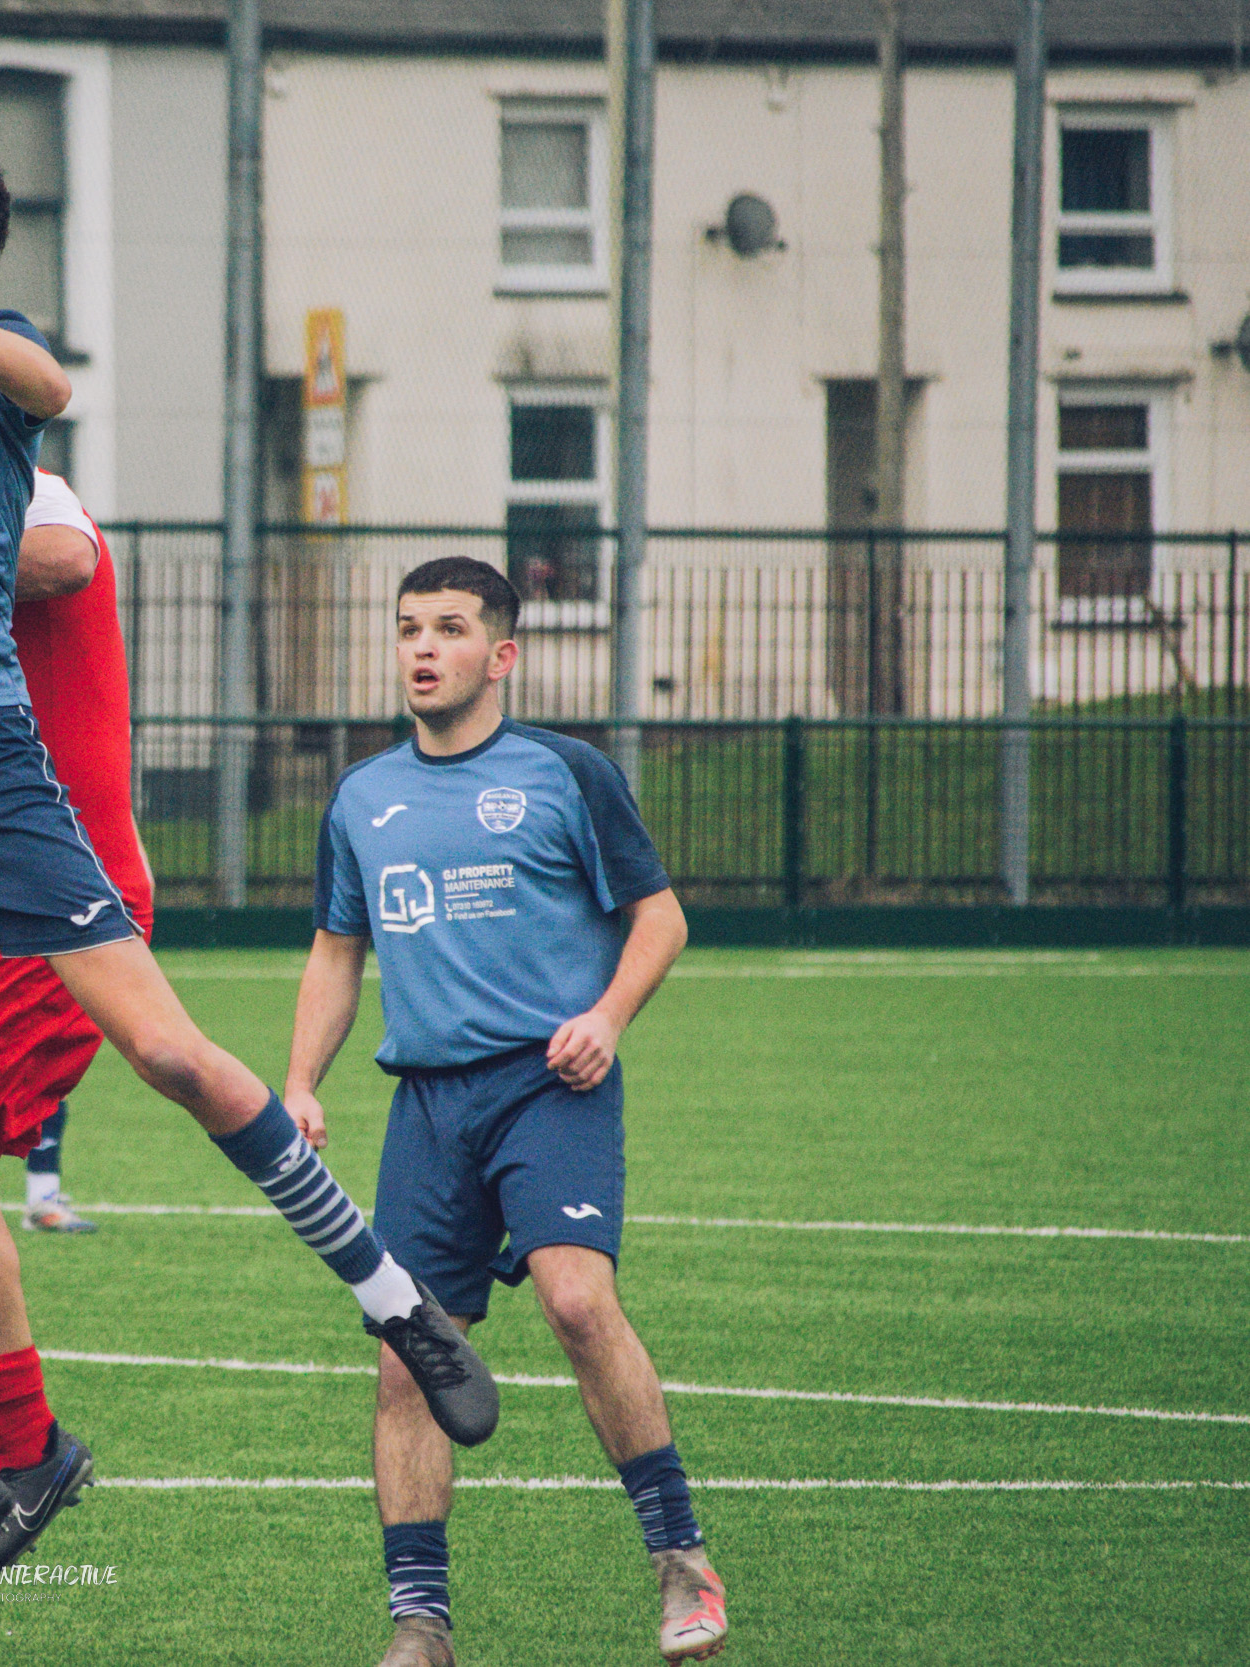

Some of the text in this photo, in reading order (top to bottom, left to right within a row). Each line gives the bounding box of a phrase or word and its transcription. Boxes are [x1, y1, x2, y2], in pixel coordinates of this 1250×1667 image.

[443, 864, 514, 880] GJ PROPERTY
[444, 877, 516, 893] MAINTENANCE
